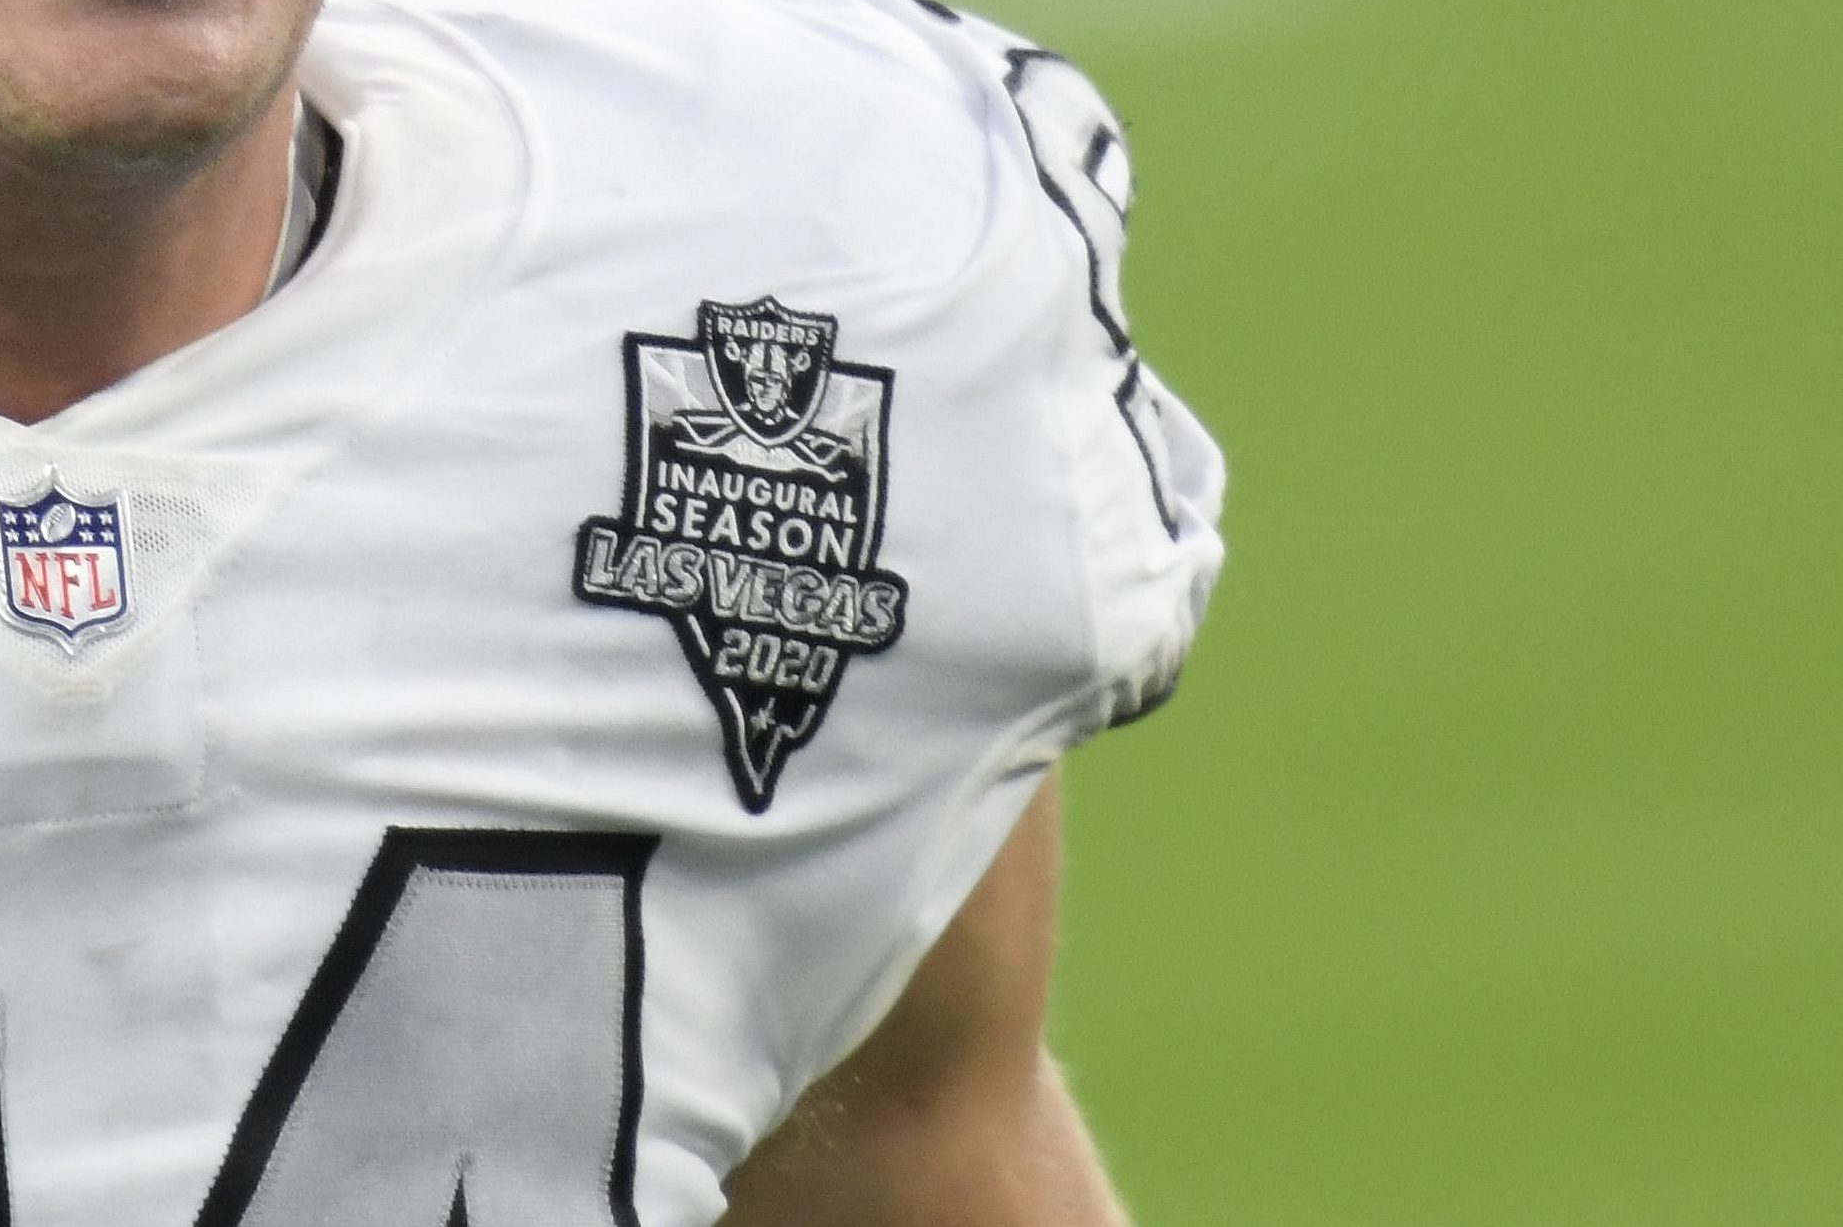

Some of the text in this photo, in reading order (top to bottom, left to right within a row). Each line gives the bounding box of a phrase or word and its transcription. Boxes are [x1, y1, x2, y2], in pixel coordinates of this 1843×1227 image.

[716, 316, 821, 347] RAIDERS
[657, 461, 858, 524] INAUGURAL
[653, 493, 854, 569] SEASON
[15, 552, 116, 620] NFL
[580, 527, 903, 645] LAS VEGAS
[714, 627, 840, 694] 2020
